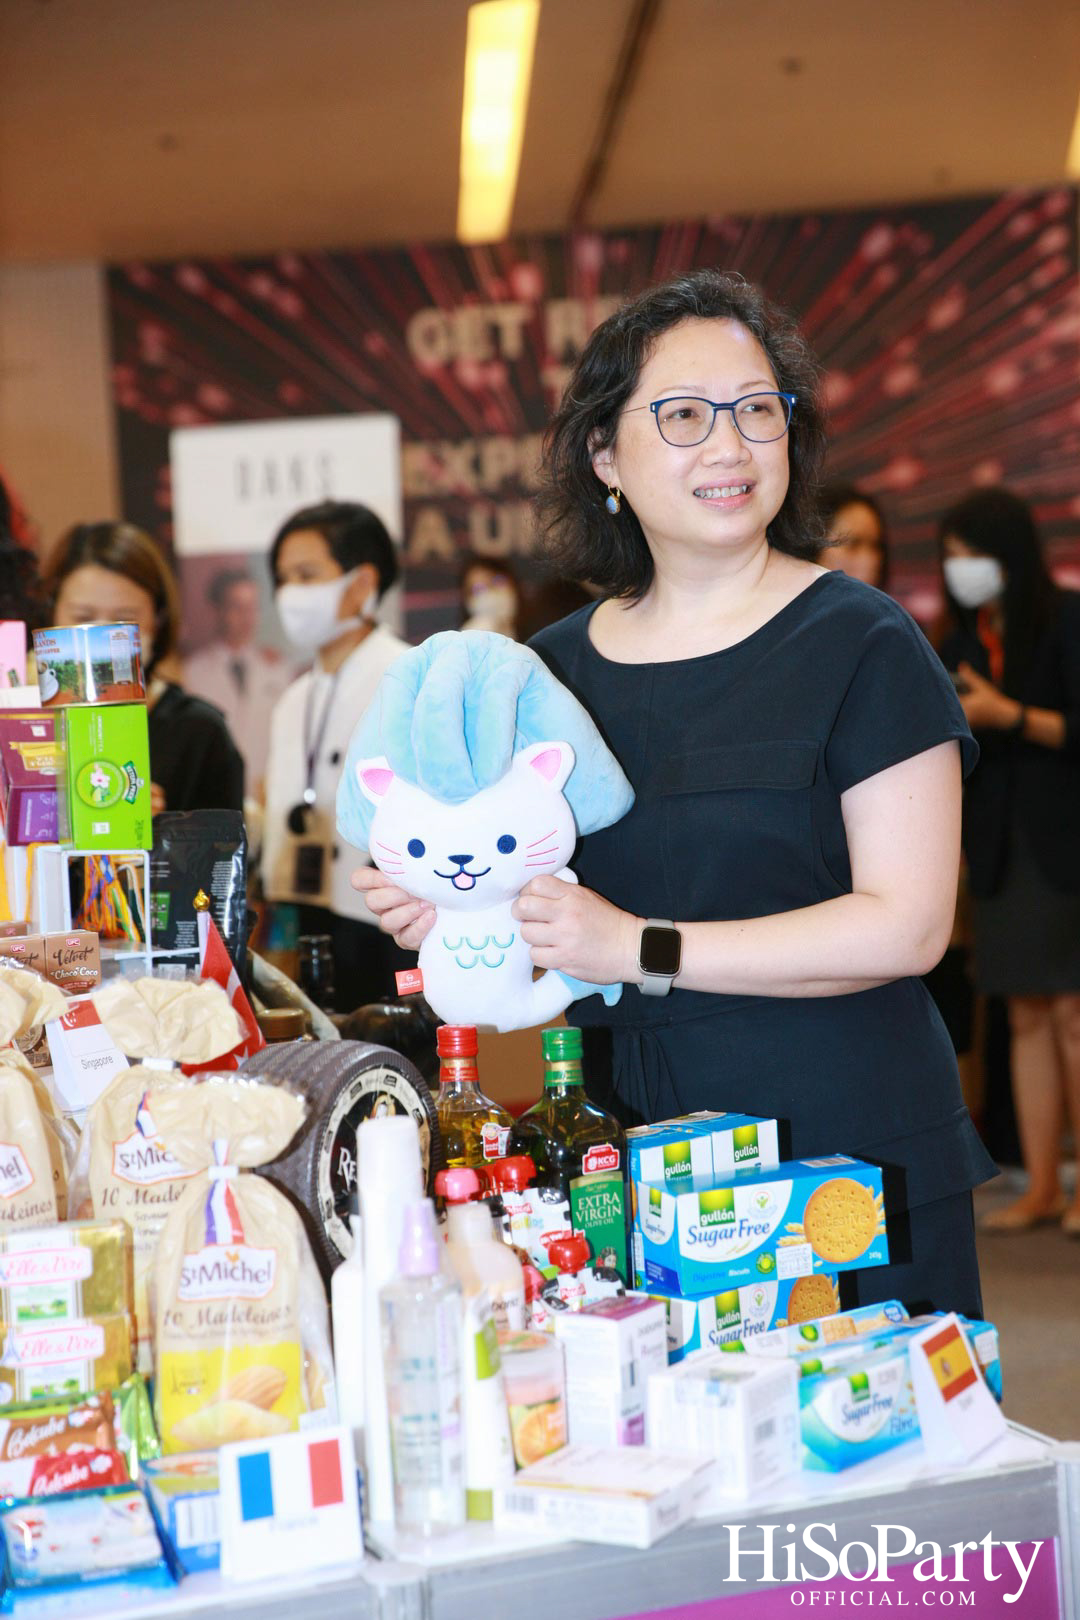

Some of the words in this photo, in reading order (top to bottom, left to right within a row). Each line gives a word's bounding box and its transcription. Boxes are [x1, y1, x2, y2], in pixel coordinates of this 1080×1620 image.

[53, 946, 94, 966] Velvet
[80, 967, 98, 977] Coco
[80, 1056, 114, 1071] Singapore
[597, 1155, 616, 1166] KCG
[734, 1144, 758, 1161] gullón
[665, 1161, 691, 1178] gullón
[578, 1192, 621, 1210] EXTRA
[575, 1204, 622, 1222] VIRGIN
[700, 1208, 735, 1227] gullón
[584, 1219, 603, 1229] OLIVE
[603, 1217, 614, 1226] OIL
[188, 1304, 291, 1329] Madeleines
[716, 1311, 741, 1328] gullón
